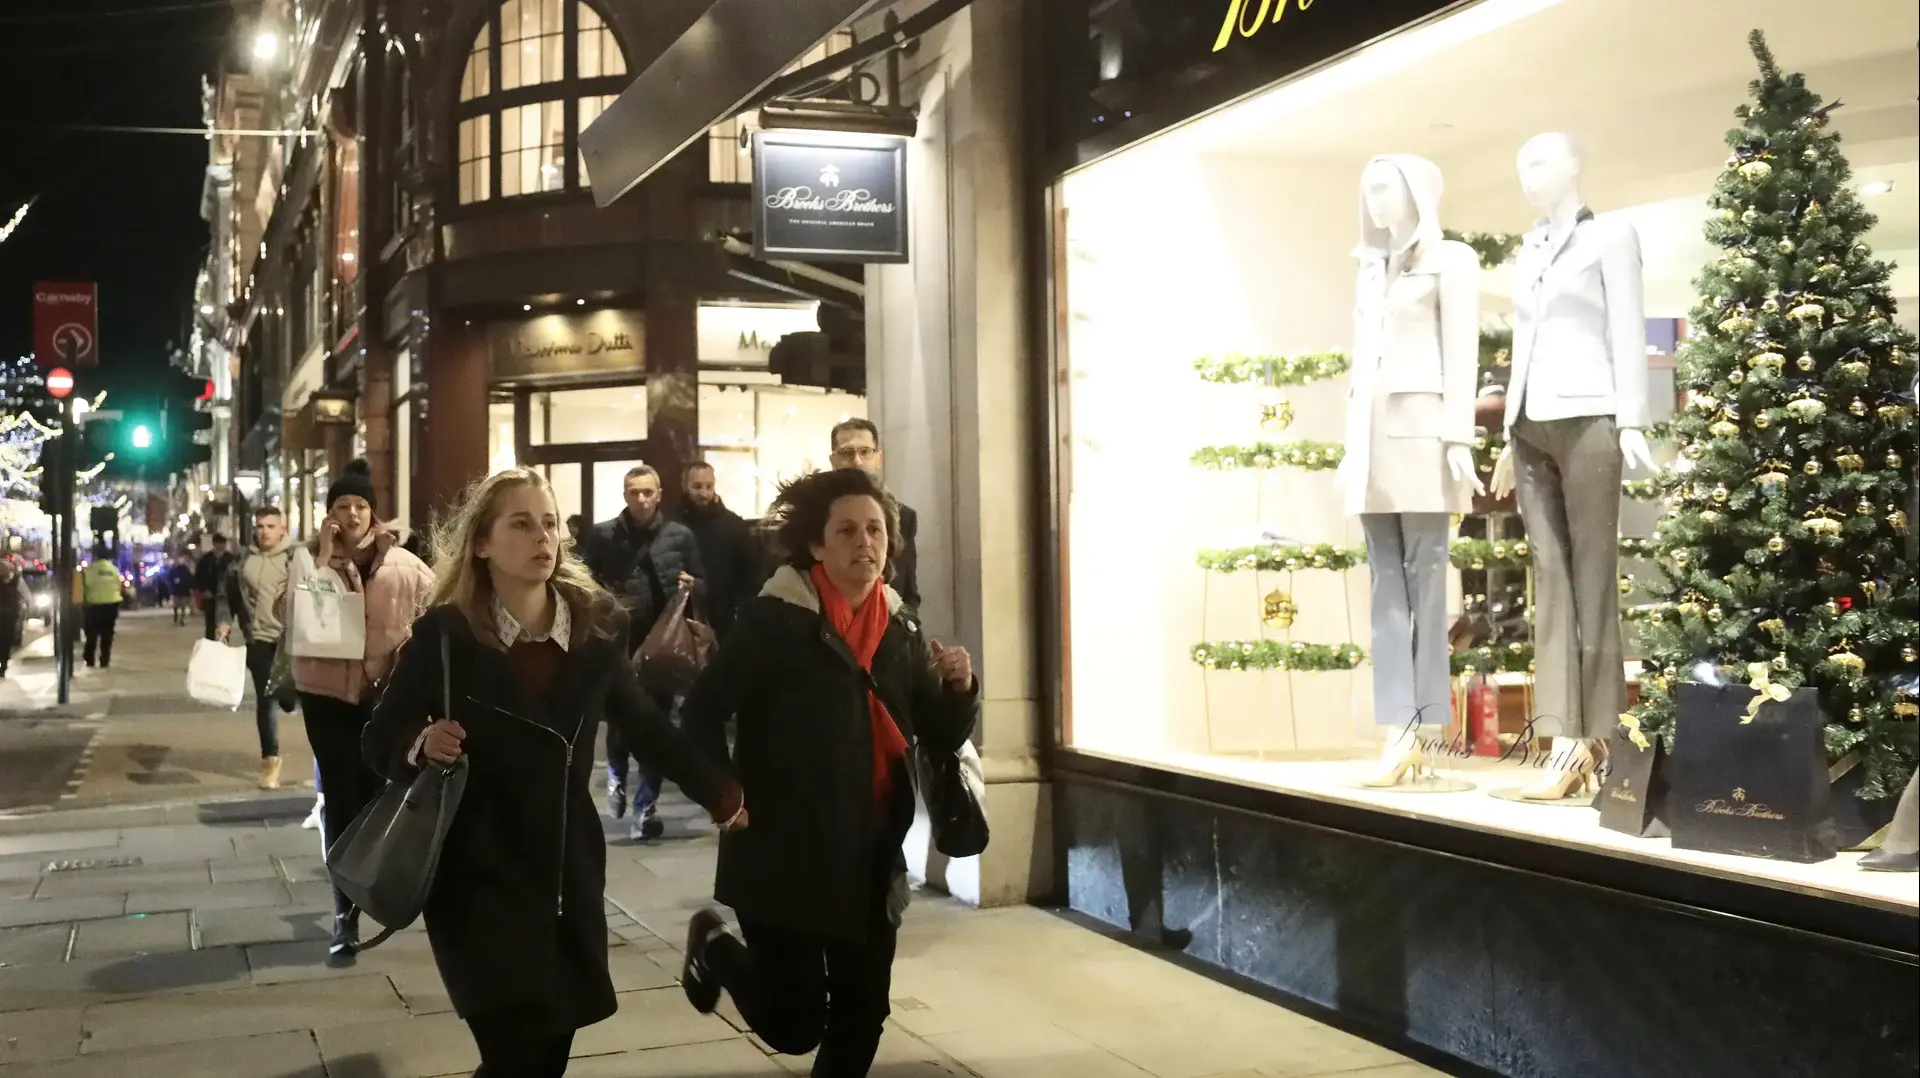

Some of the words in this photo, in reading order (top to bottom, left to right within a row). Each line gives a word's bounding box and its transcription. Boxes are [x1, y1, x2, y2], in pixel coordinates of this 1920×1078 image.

[766, 186, 825, 211] Brooks
[825, 188, 895, 213] Brothers
[36, 293, 92, 305] Carnaby
[1395, 703, 1474, 759] Brooks
[1496, 714, 1614, 777] Brothers
[1694, 799, 1735, 815] Brooks
[1735, 803, 1786, 820] Brothers
